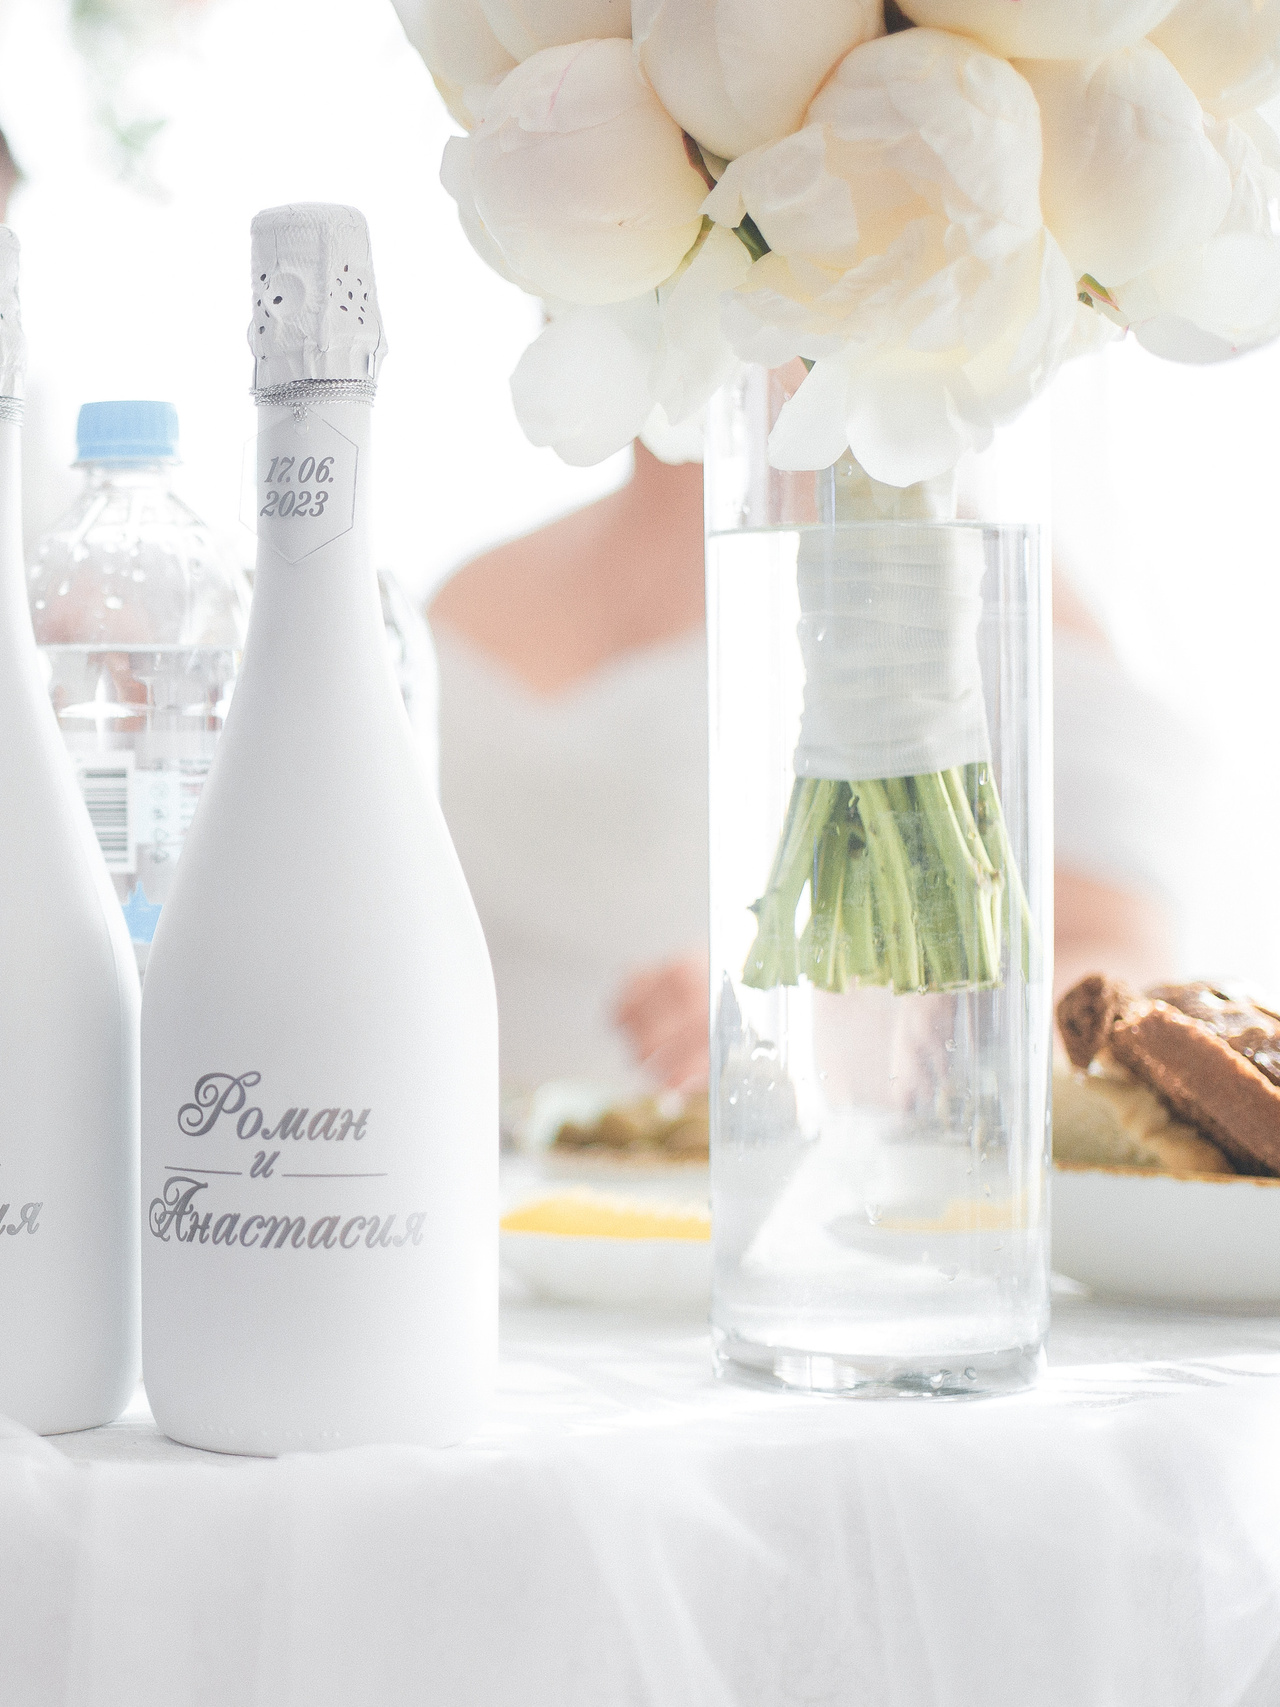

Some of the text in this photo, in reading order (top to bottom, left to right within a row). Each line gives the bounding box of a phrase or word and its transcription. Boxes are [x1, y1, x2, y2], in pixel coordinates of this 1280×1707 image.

[264, 456, 335, 483] 17.06.
[259, 490, 329, 517] 2023
[177, 1070, 371, 1141] Роман
[249, 1150, 280, 1178] и
[149, 1176, 427, 1249] Анастасия
